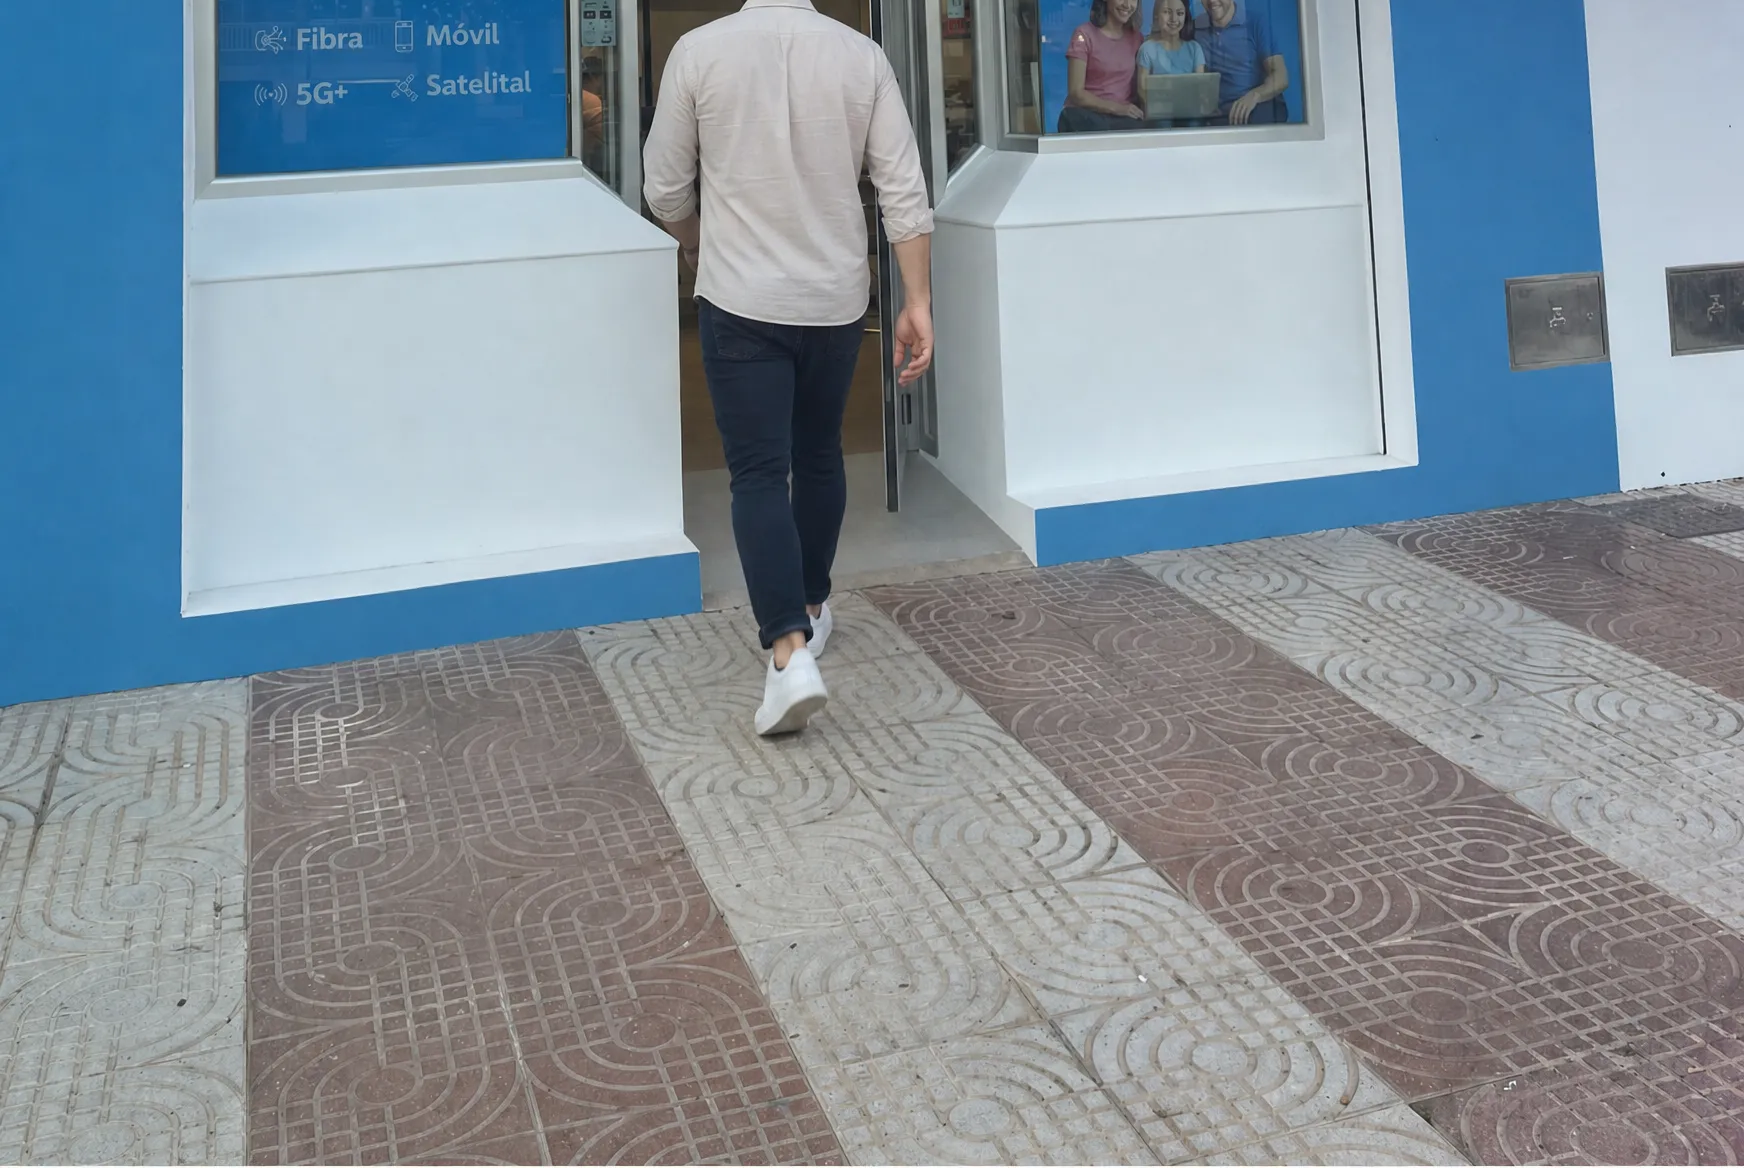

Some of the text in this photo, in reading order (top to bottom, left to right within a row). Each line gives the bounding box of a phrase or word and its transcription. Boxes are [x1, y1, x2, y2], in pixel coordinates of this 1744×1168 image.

[297, 27, 363, 51] Fibra
[426, 23, 500, 47] Móvil
[296, 81, 348, 106] 5G+
[427, 70, 532, 97] Satelital
